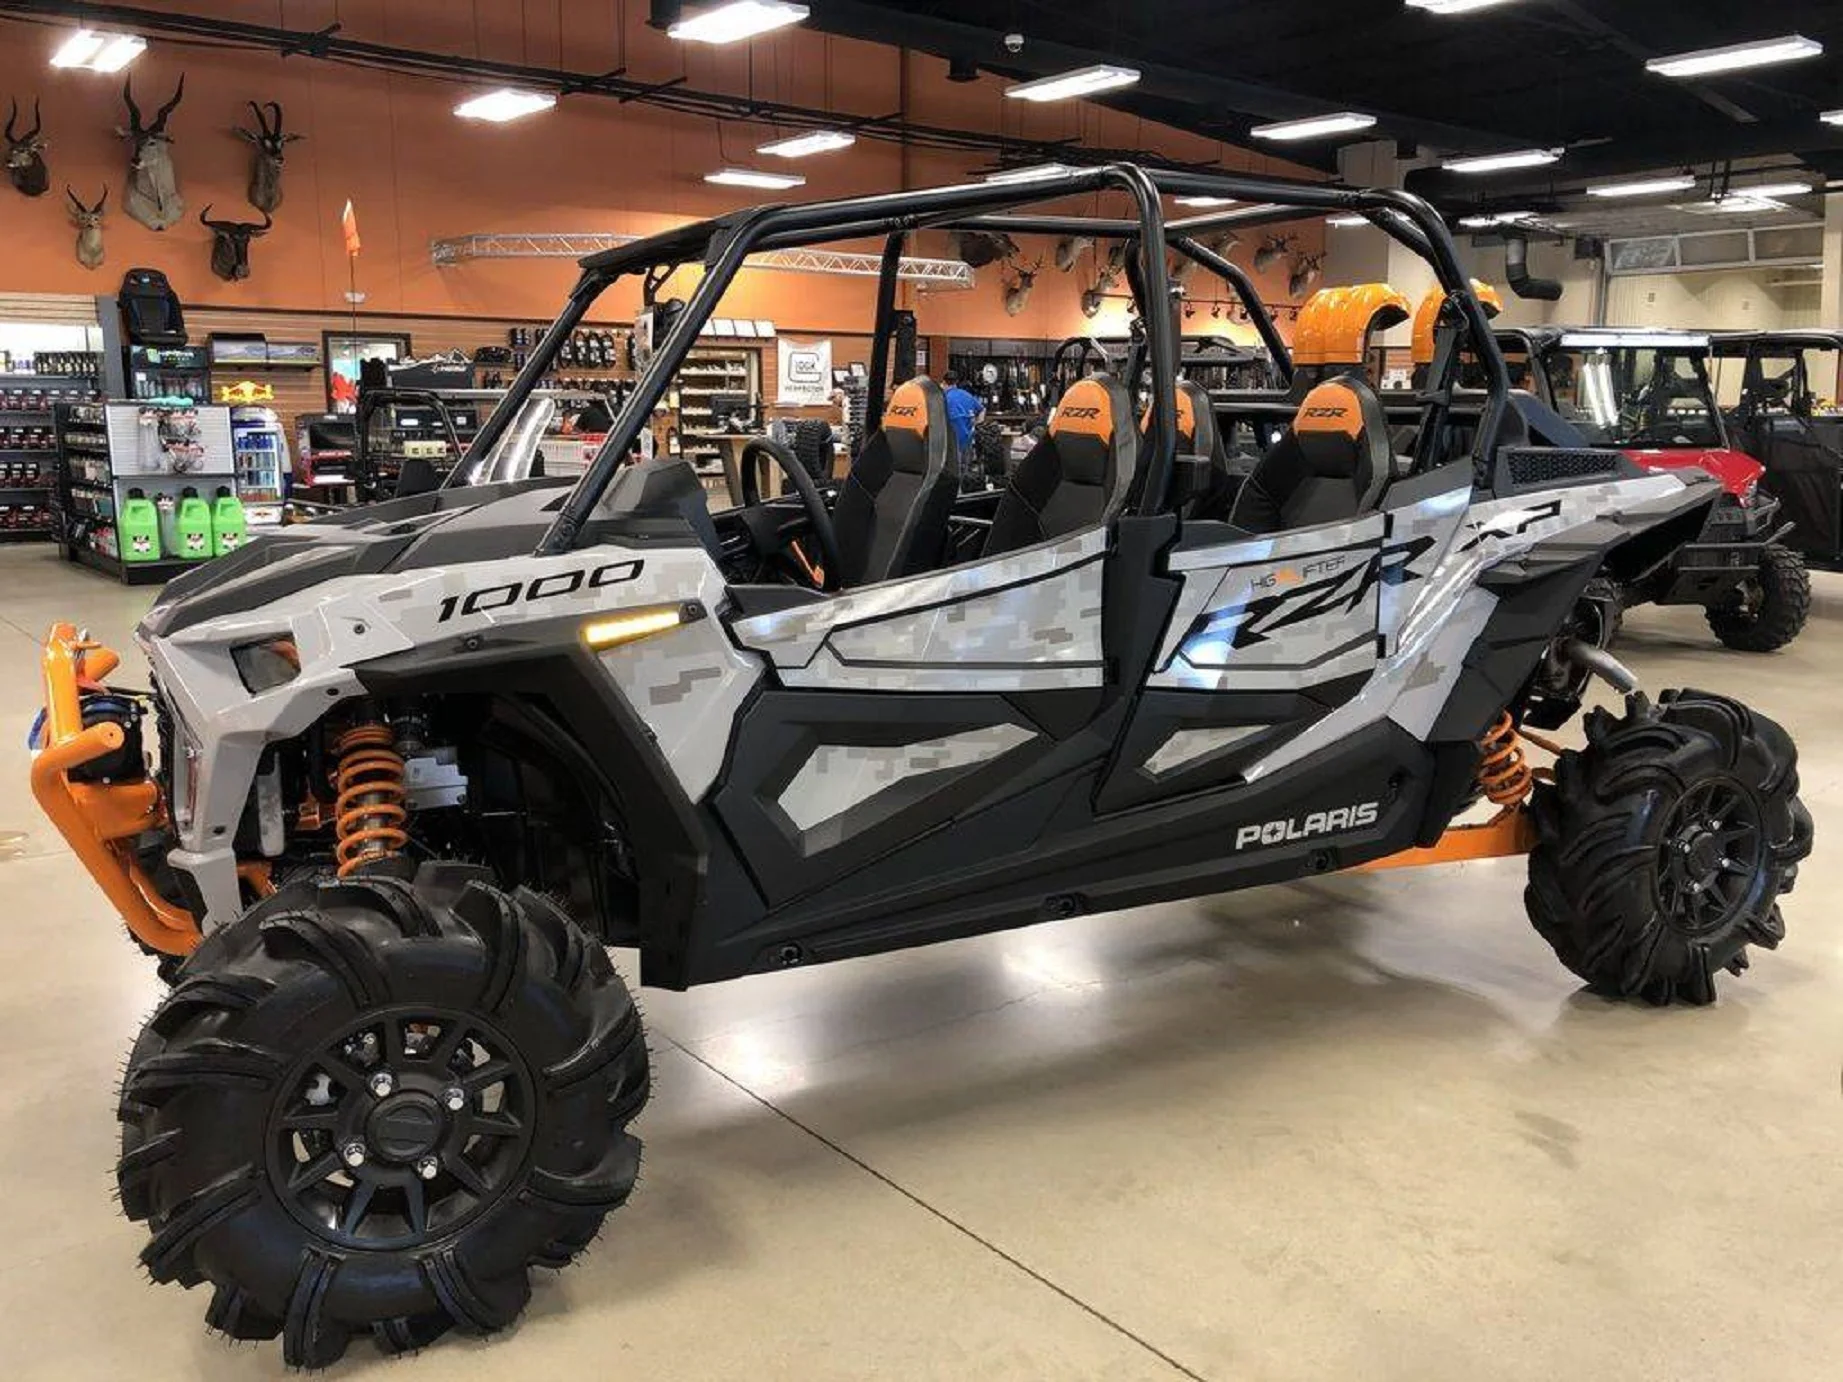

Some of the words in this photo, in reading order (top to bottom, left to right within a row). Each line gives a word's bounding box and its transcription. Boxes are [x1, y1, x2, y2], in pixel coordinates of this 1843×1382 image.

[890, 404, 917, 417] RZR
[1062, 407, 1100, 419] RZR
[1303, 407, 1348, 417] RZR
[1456, 499, 1561, 553] XP
[438, 559, 645, 623] 1000
[1180, 535, 1436, 650] RZR
[1235, 802, 1379, 850] POLARIS
